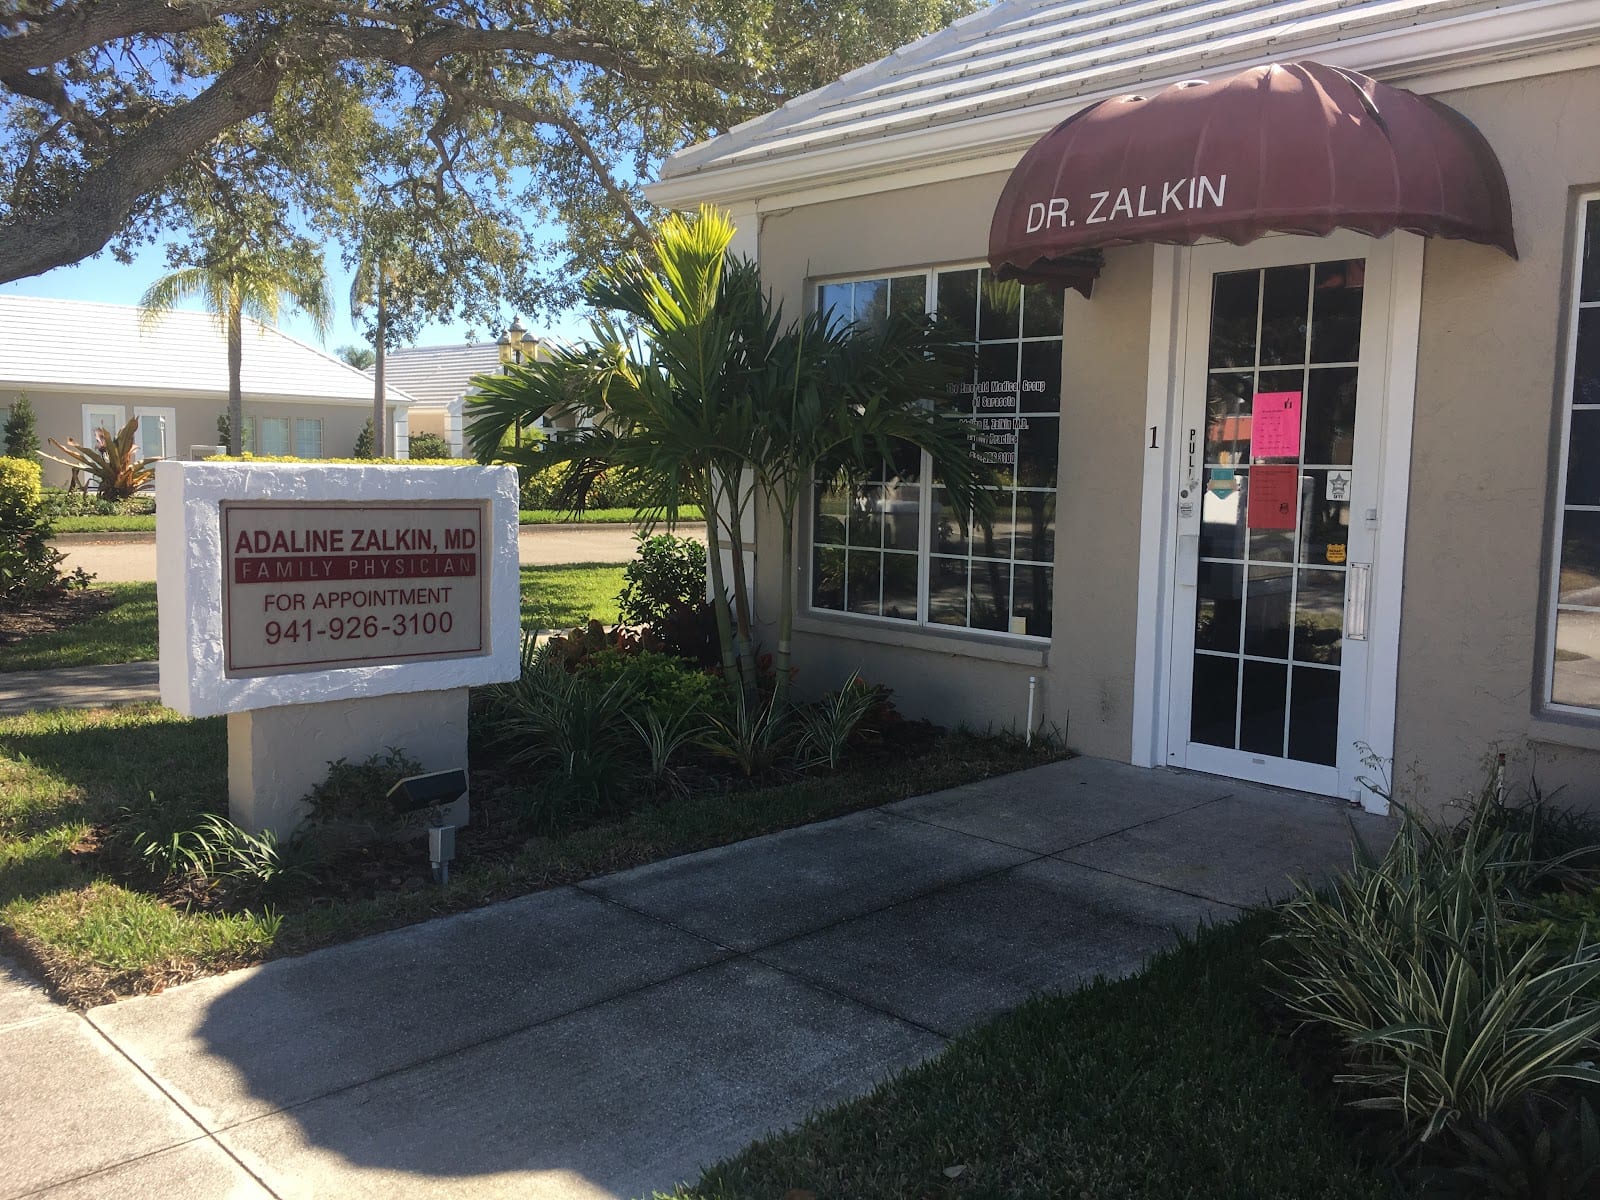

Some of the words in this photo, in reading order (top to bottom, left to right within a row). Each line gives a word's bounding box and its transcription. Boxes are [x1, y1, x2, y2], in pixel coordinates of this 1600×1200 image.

[1026, 198, 1075, 233] DR.
[1086, 174, 1227, 224] ZALKIN
[990, 381, 1020, 393] Medical
[1022, 380, 1046, 392] Group
[982, 396, 1016, 407] Sarasota
[1149, 426, 1159, 448] 1
[234, 529, 344, 554] ADALINE
[351, 528, 437, 554] ZALKIN,
[444, 528, 476, 550] MD
[242, 560, 333, 579] FAMILY
[349, 557, 471, 578] PHYSICIAN
[264, 593, 305, 612] FOR
[312, 587, 453, 610] APPOINTMENT
[265, 611, 453, 645] 941-926-3100
